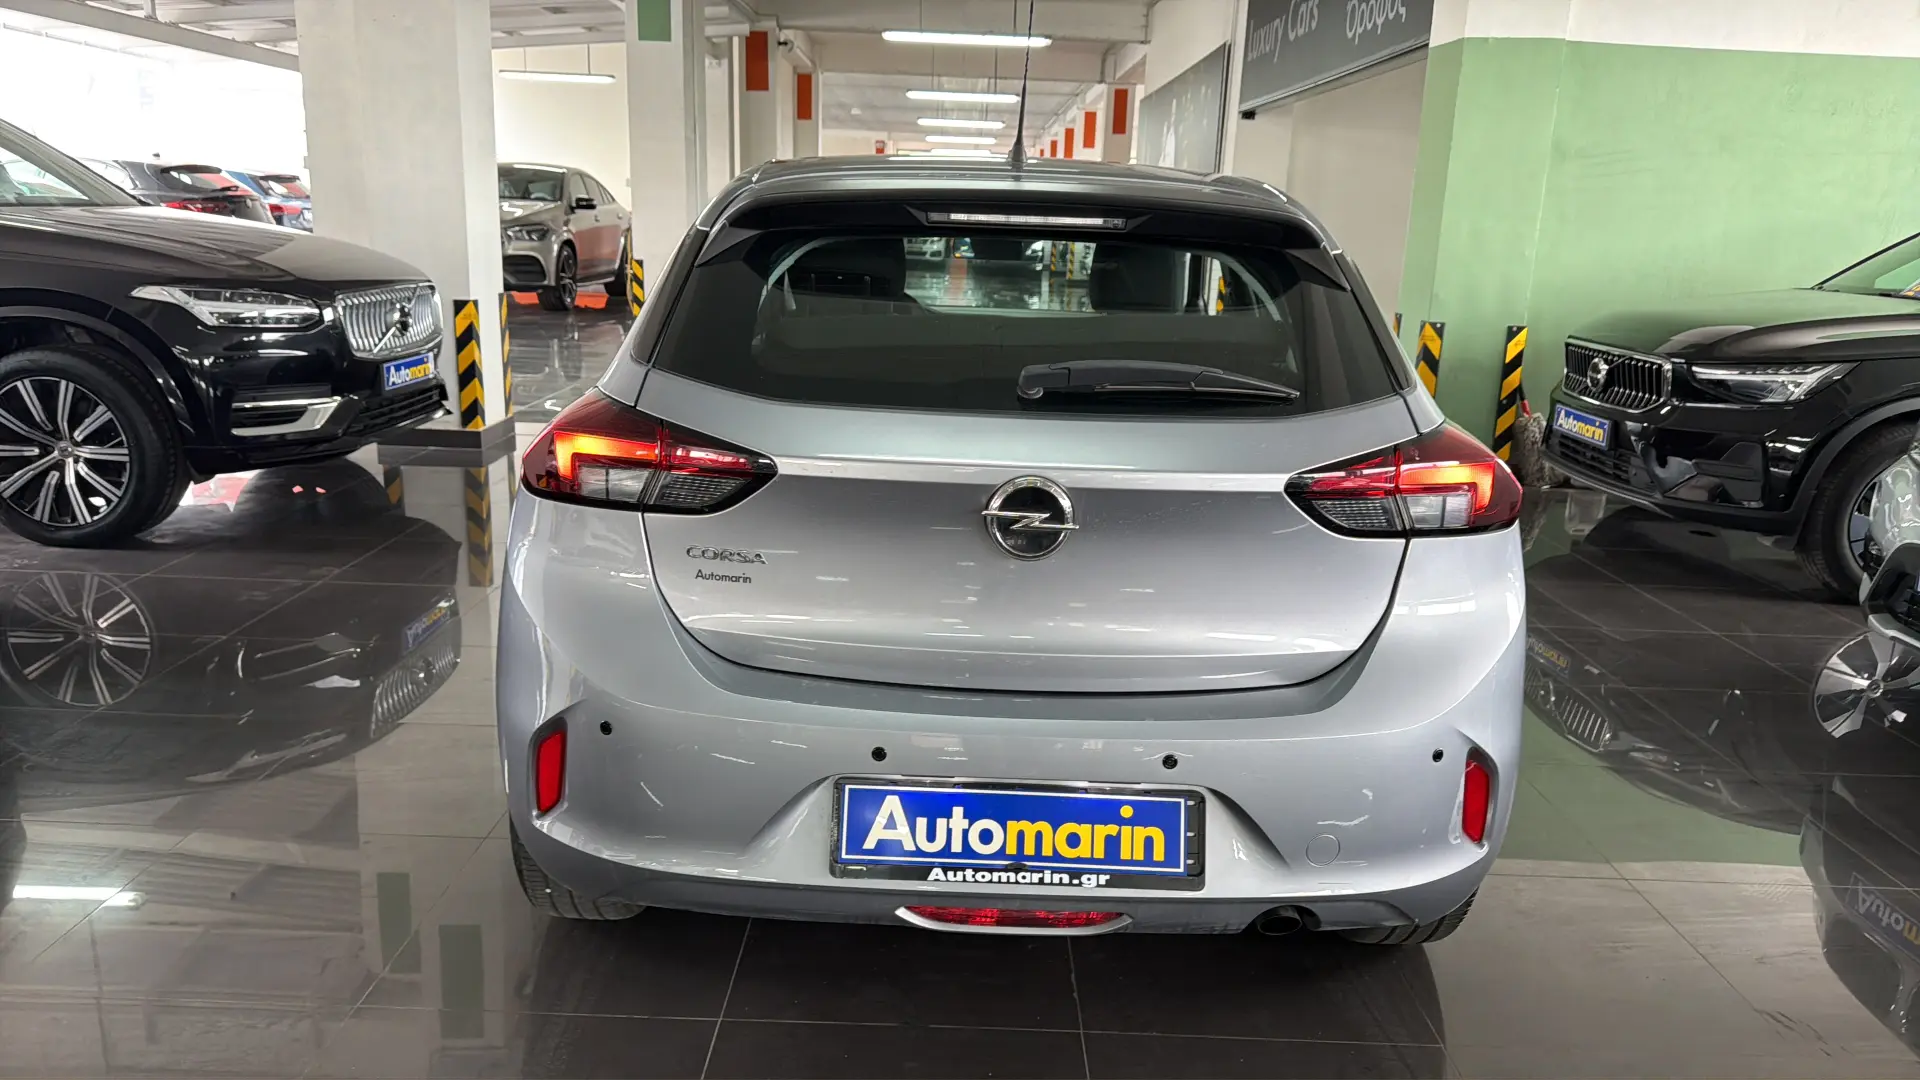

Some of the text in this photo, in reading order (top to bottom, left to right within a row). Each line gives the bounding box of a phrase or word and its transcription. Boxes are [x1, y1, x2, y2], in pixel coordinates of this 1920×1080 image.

[1247, 0, 1319, 64] Luxury Cars
[1557, 409, 1604, 441] Automarin
[686, 544, 768, 565] CORSA
[695, 569, 752, 584] Automarin
[862, 795, 1165, 862] Automarin
[927, 867, 1111, 888] Automarin.gr
